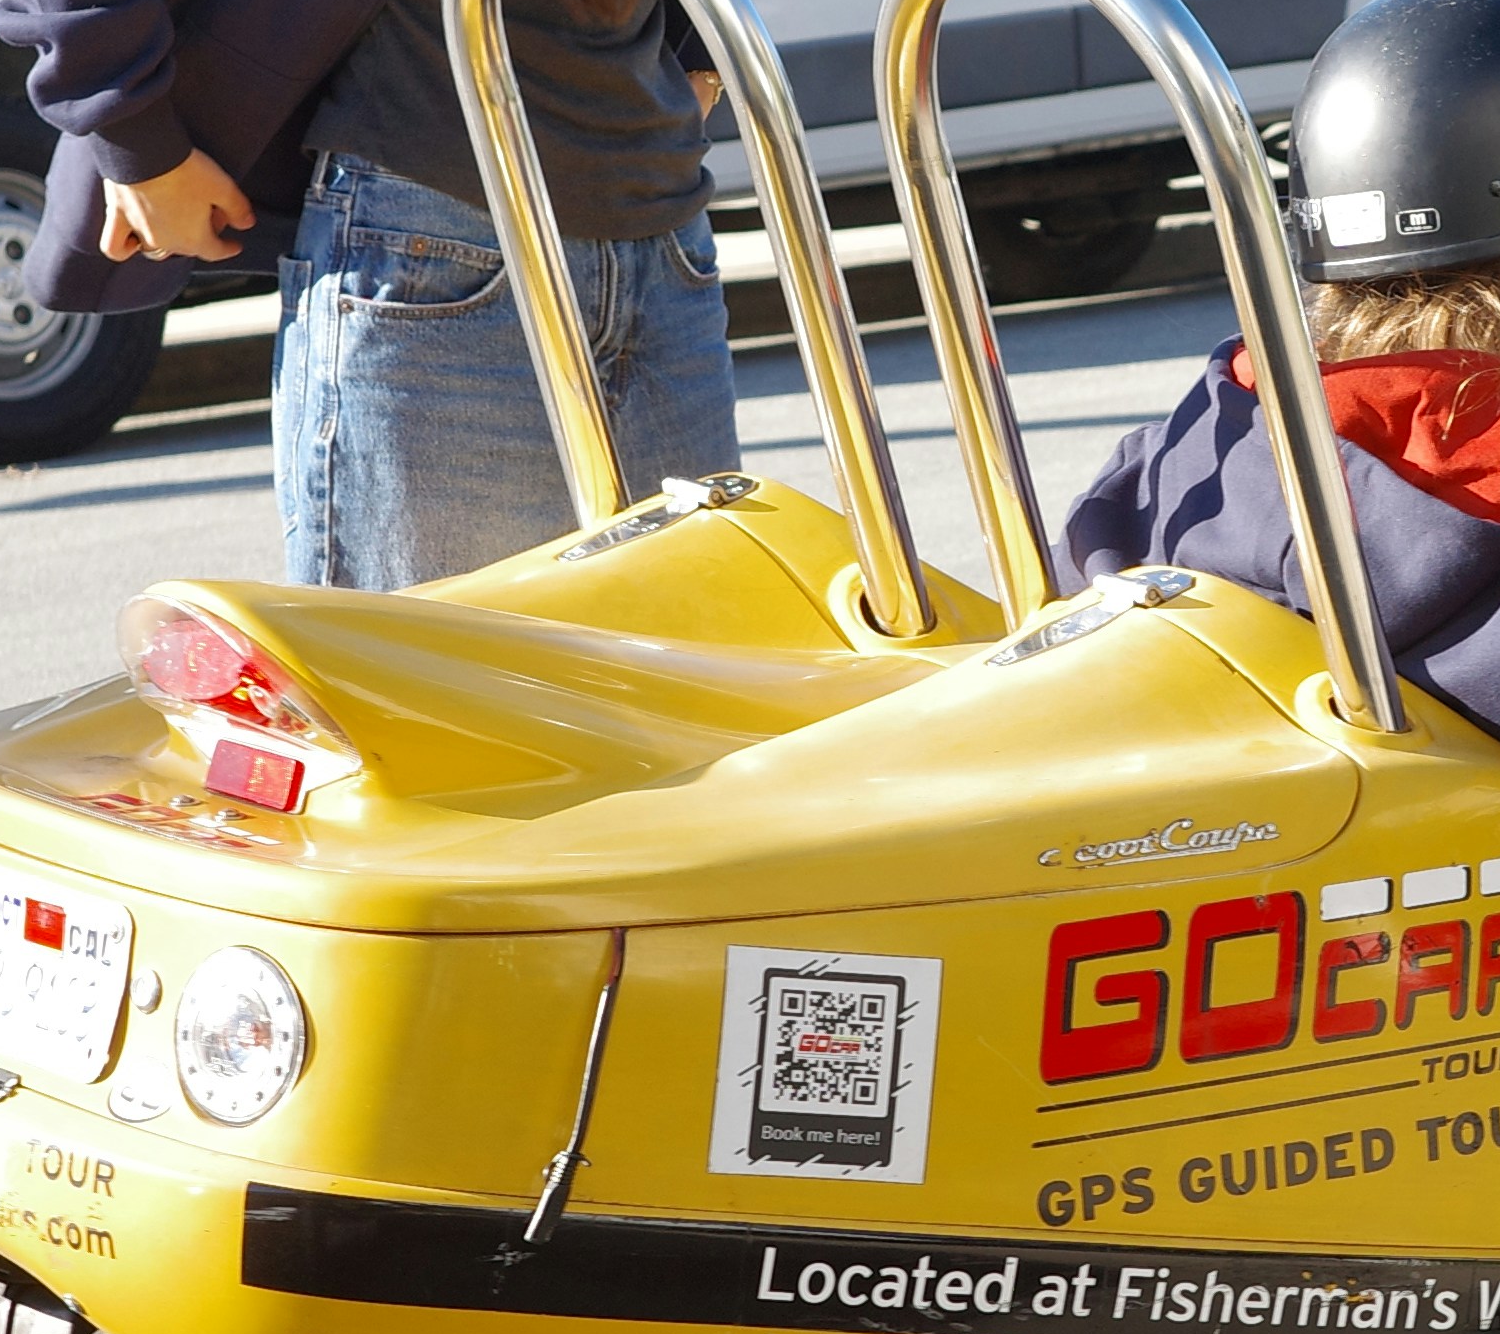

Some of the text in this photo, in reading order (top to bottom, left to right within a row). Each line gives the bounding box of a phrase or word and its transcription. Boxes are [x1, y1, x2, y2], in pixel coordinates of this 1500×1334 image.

[69, 924, 112, 968] CAL
[761, 1125, 881, 1146] Book me here!
[25, 1138, 116, 1198] TOUR
[1037, 1166, 1155, 1227] GPS
[1179, 1128, 1396, 1204] GUIDED
[757, 1247, 1020, 1315] Located
[1030, 1262, 1098, 1319] at
[1112, 1268, 1459, 1332] Fisherman's
